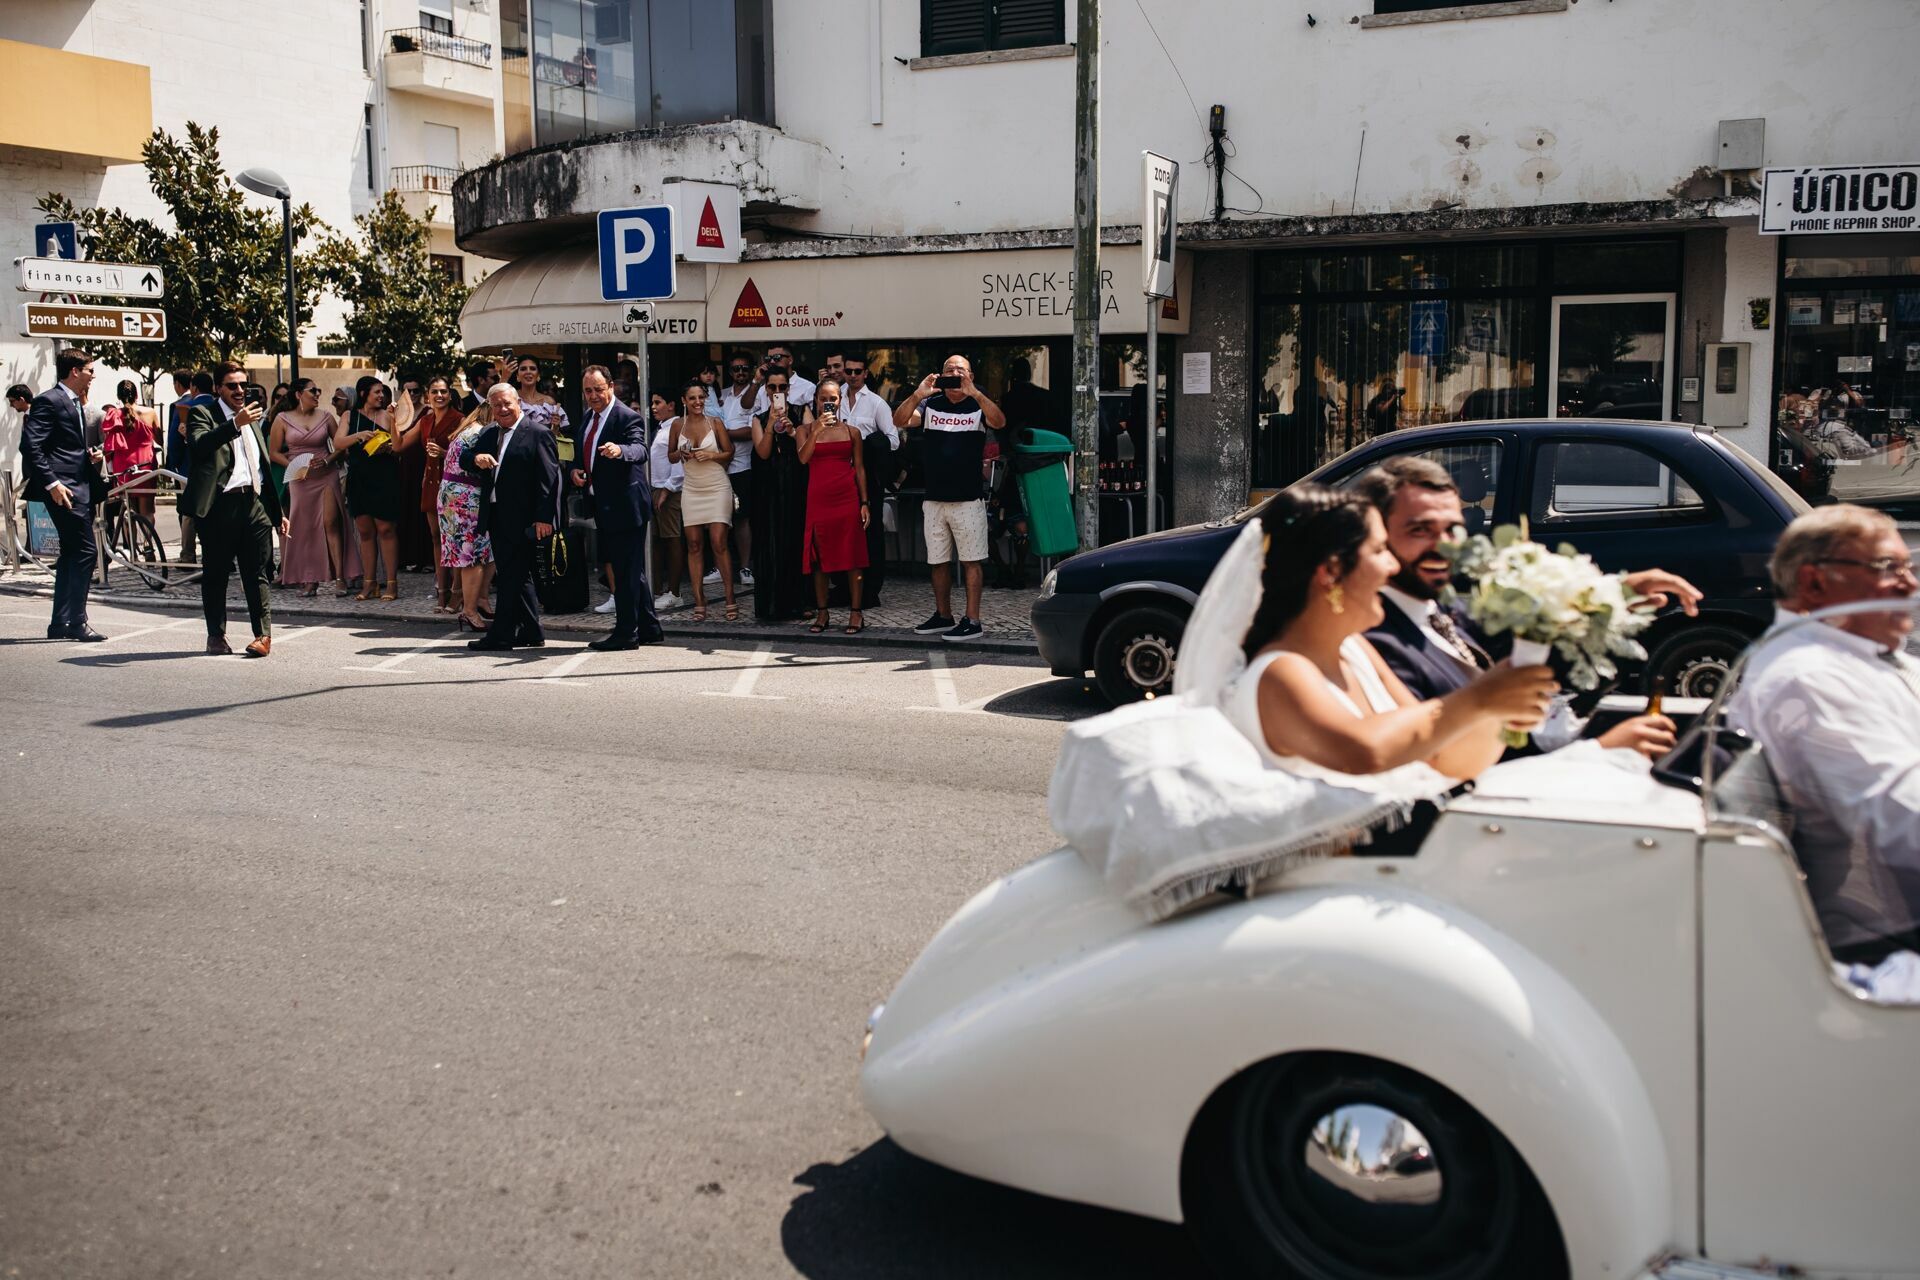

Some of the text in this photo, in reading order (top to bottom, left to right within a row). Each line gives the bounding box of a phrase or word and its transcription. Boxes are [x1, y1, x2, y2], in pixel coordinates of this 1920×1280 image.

[1154, 167, 1171, 185] zona
[1792, 168, 1918, 214] ÚNICO
[1790, 216, 1916, 231] PHONE REPAIR SHOP
[701, 226, 719, 237] DELTA
[613, 217, 655, 292] P
[28, 269, 102, 285] finanças
[982, 270, 1114, 294] SNACK-R
[737, 307, 764, 317] DELTA
[776, 304, 809, 315] O CAFÉ
[982, 294, 1120, 318] PASTELAA
[30, 314, 117, 328] zona ribeirinha
[559, 322, 619, 335] PASTELARIA
[647, 319, 698, 334] AVETO
[776, 317, 836, 327] DA SUA VIDA
[930, 414, 975, 426] Reebok
